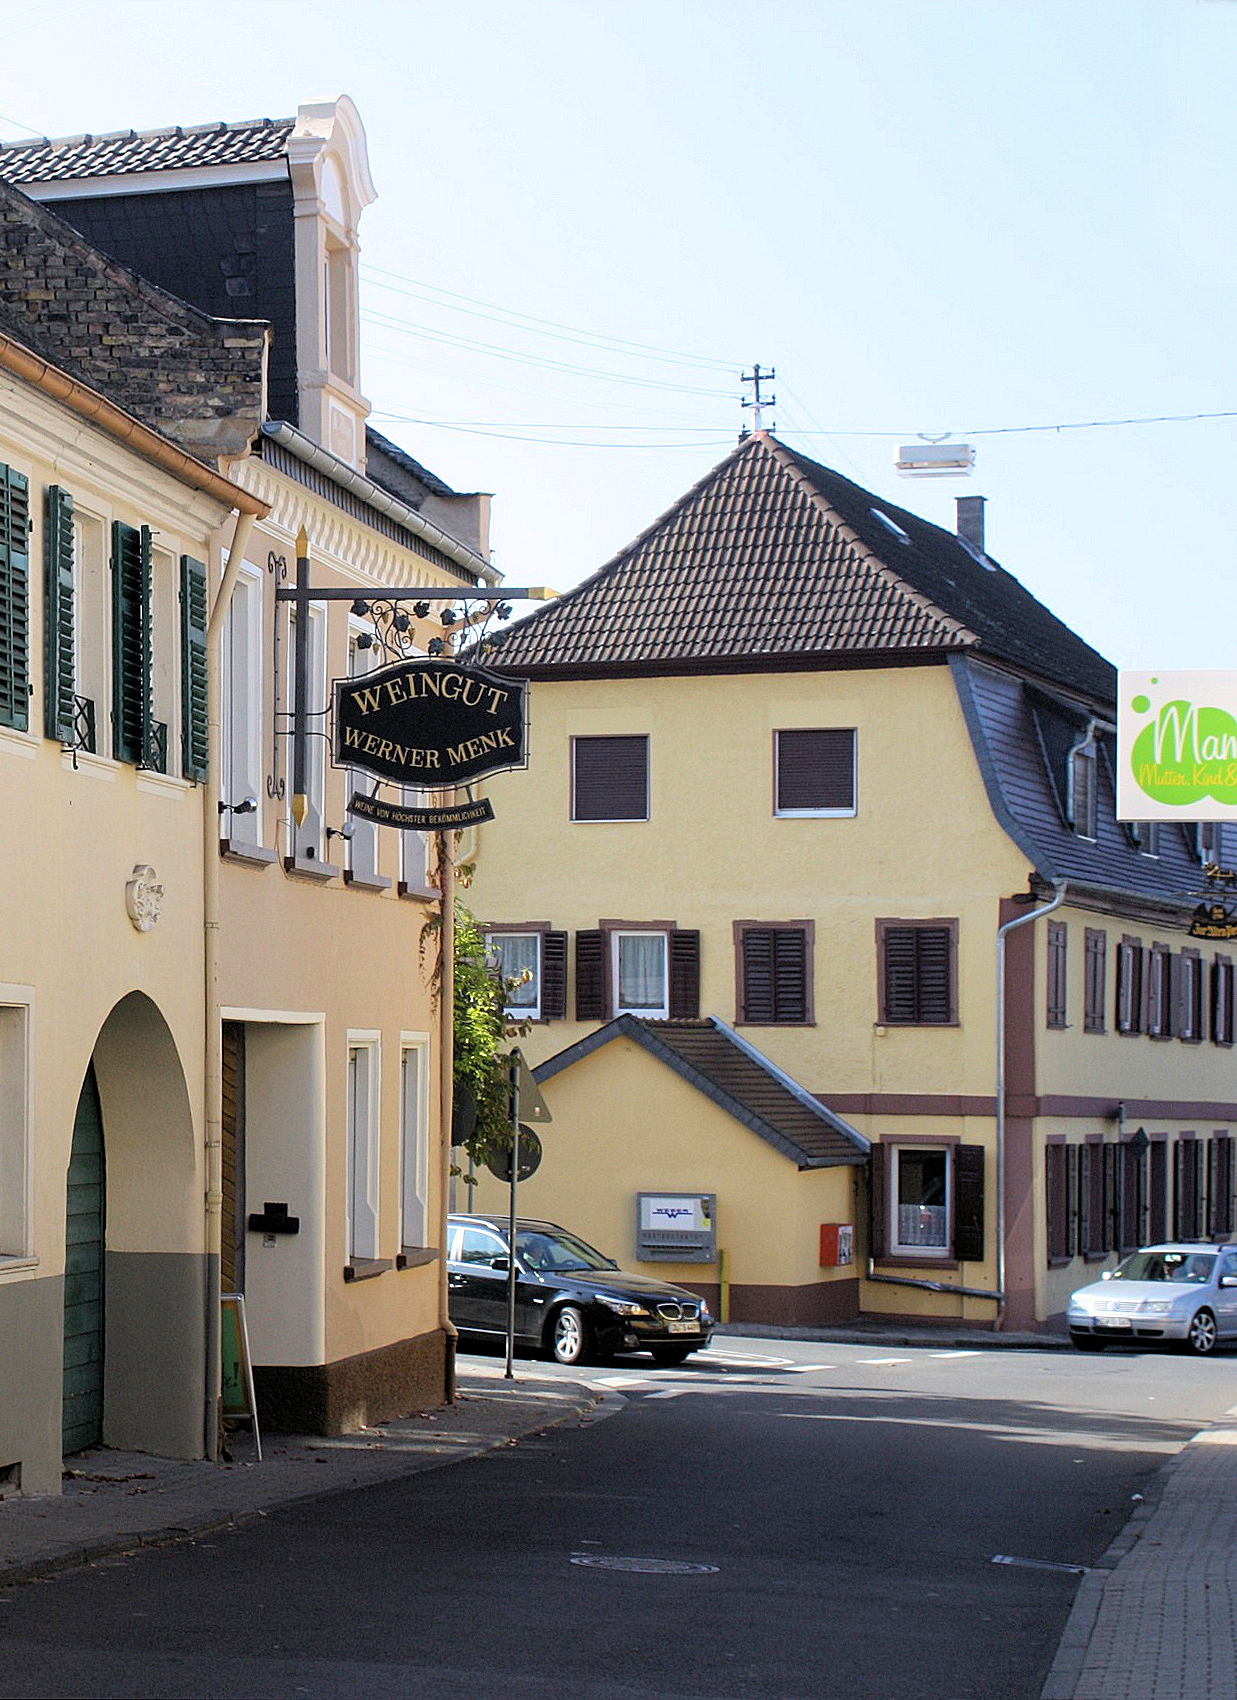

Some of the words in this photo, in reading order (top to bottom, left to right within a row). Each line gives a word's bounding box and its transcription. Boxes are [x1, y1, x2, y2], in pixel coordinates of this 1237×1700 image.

[351, 671, 508, 716] WEINGUT
[344, 726, 441, 769] WERNER
[446, 726, 516, 767] MENK
[1193, 763, 1222, 786] Kind
[354, 799, 375, 815] WEINE
[376, 807, 390, 819] VON
